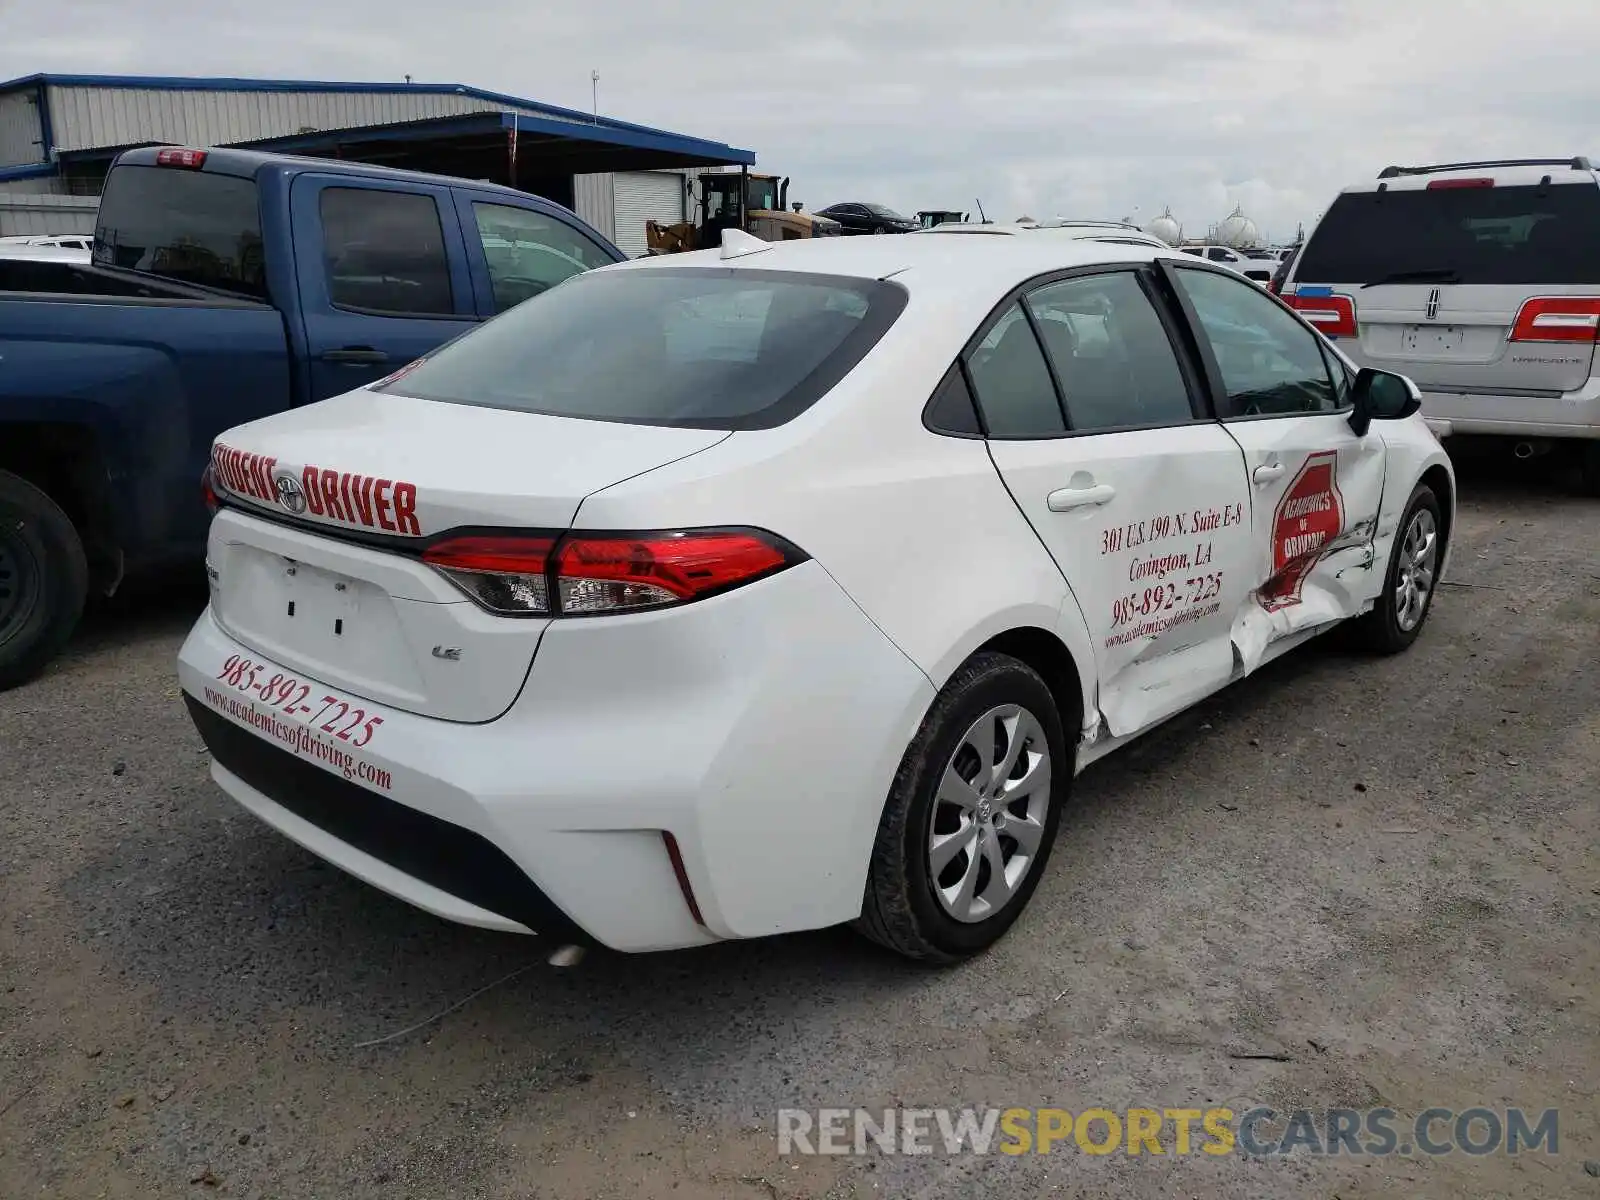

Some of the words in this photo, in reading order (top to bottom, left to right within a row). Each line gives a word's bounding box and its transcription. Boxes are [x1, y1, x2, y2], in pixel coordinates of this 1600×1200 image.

[303, 465, 421, 536] DRIVER
[1101, 528, 1123, 555] 301
[1127, 521, 1145, 548] U.S.
[1149, 515, 1170, 541] 190
[1173, 513, 1187, 536] N.
[1191, 508, 1221, 534] Suite
[1224, 502, 1242, 527] E-8
[1283, 491, 1330, 520] ACADEMICS
[1129, 553, 1191, 582] Covington,
[1195, 541, 1212, 566] LA
[1111, 571, 1223, 629] 985-892-7225
[217, 654, 385, 747] 985-892-7225
[204, 686, 392, 791] www.academicsofdriving.com
